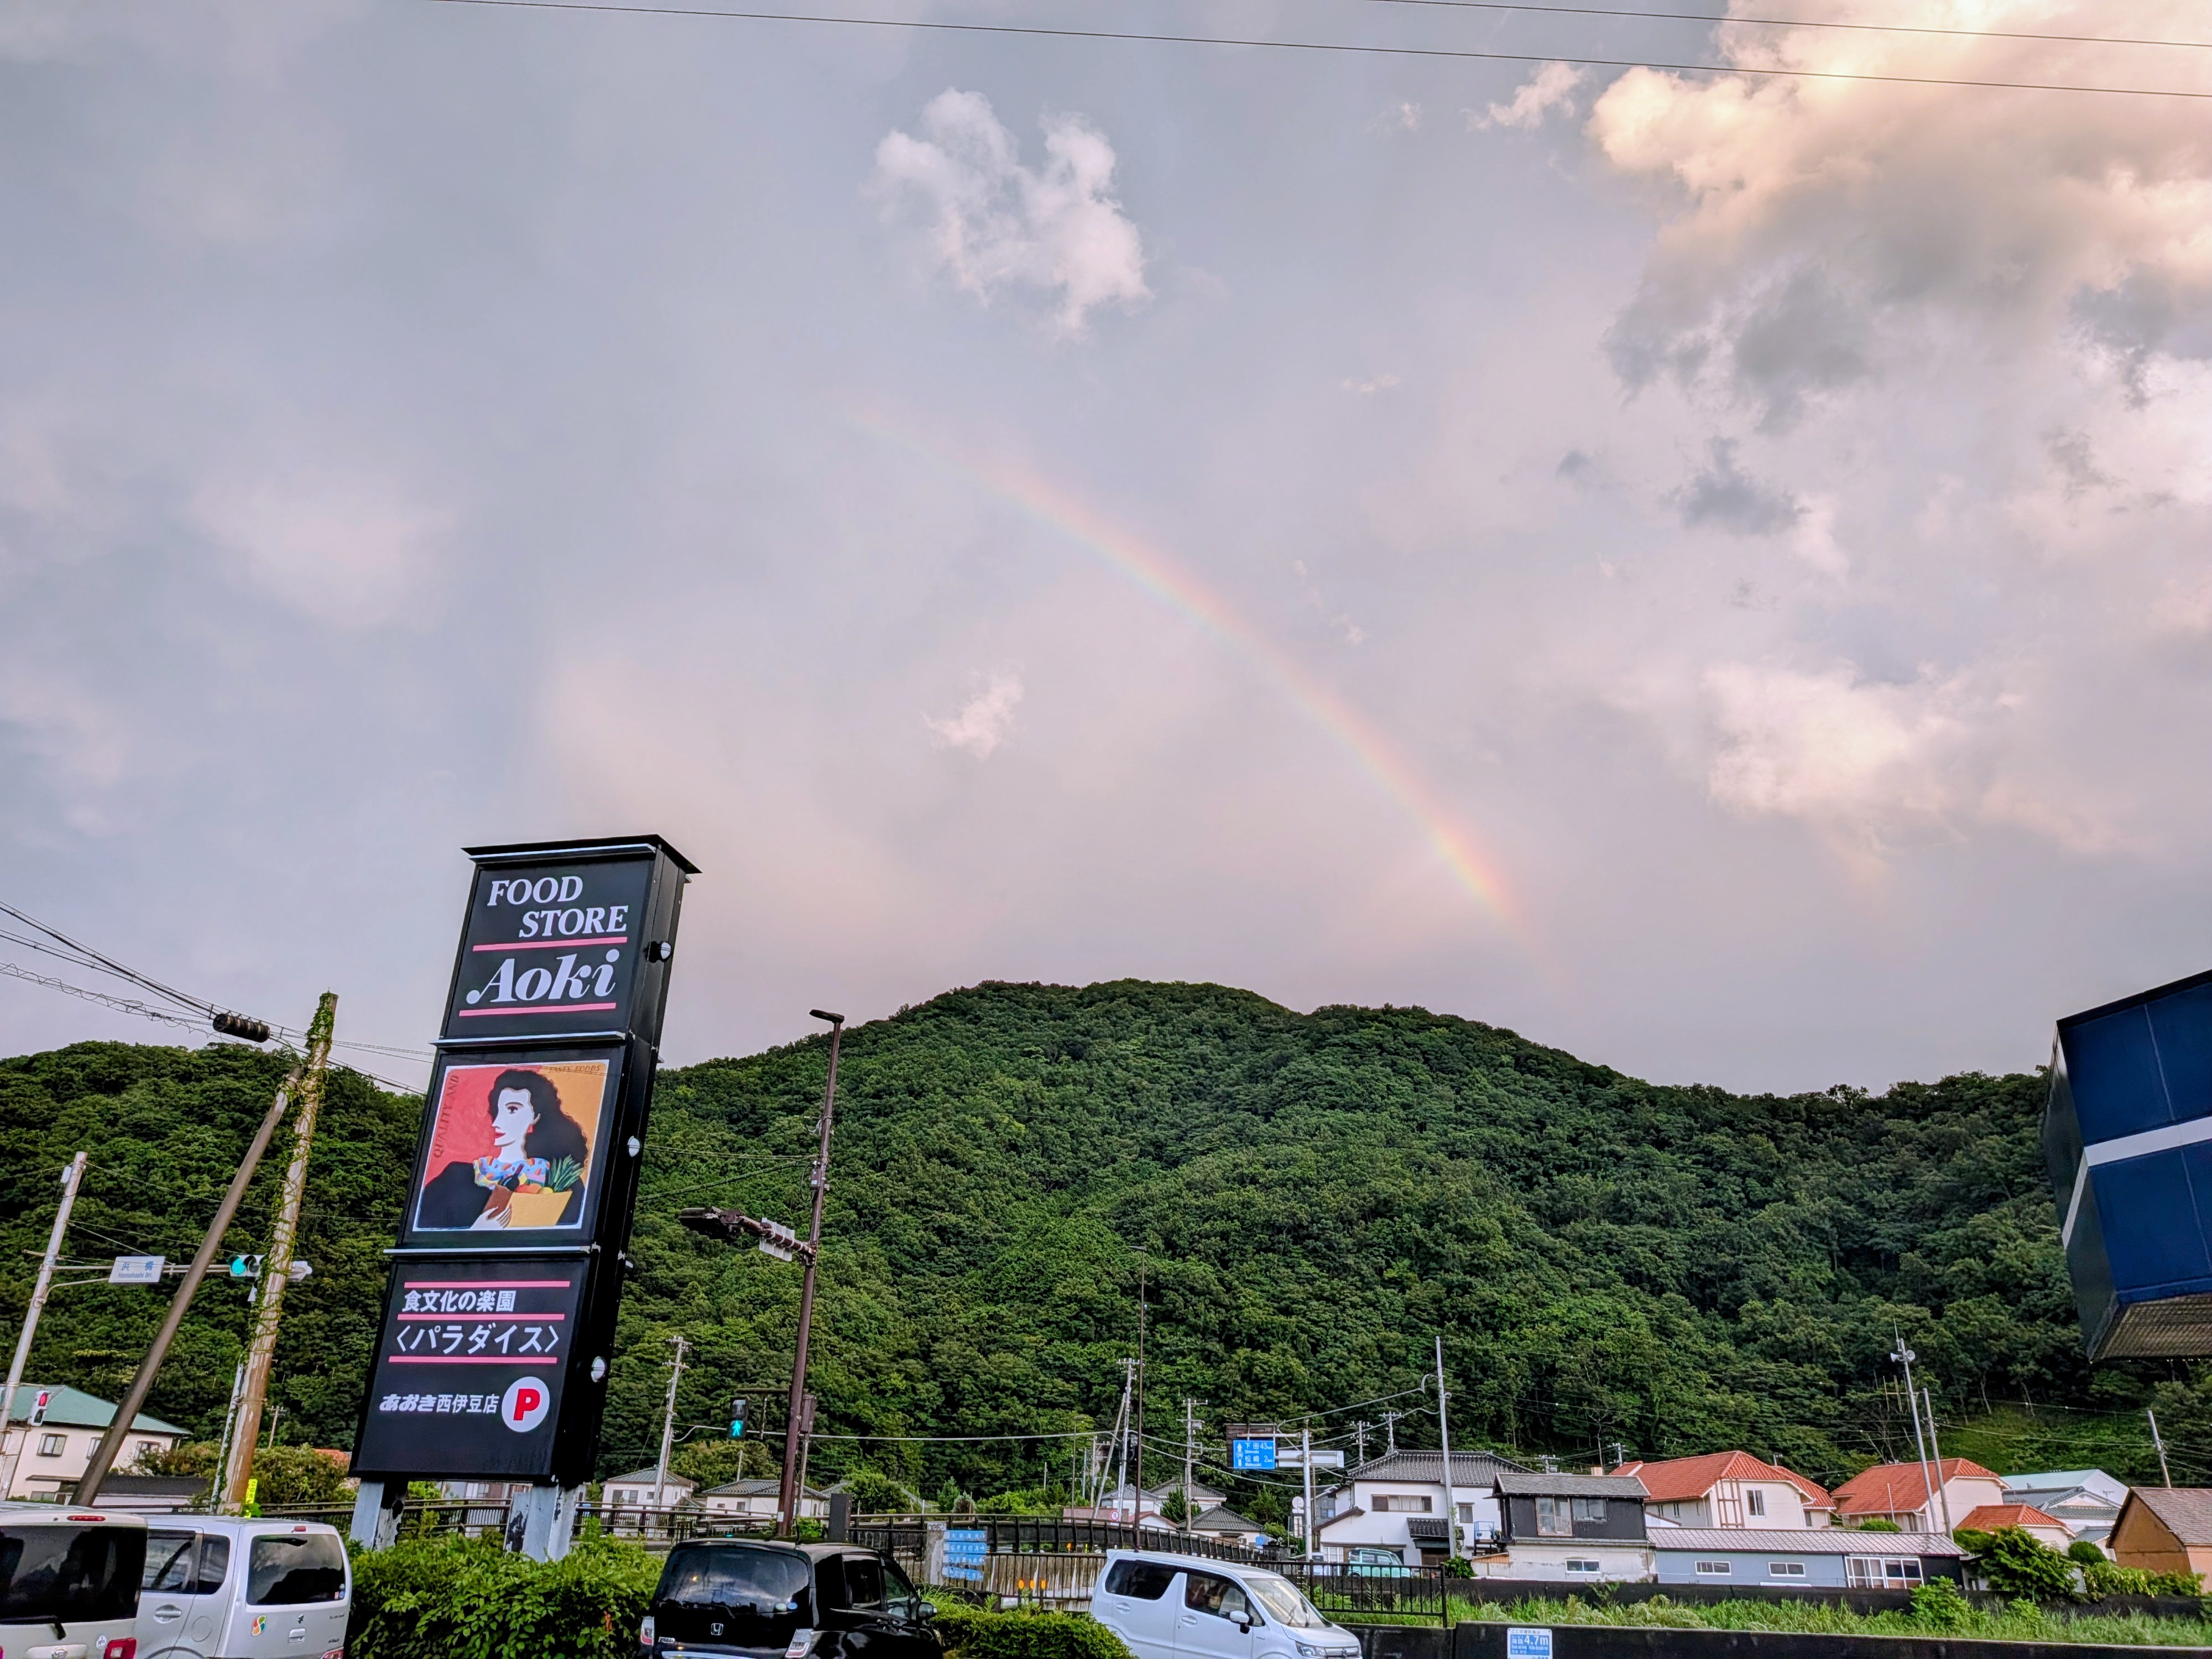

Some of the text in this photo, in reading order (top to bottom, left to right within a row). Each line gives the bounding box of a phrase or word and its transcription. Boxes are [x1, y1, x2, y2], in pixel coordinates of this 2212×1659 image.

[487, 876, 583, 906] FOOD
[519, 905, 629, 938] STORE
[466, 948, 620, 1004] Aoki
[434, 1075, 459, 1158] QUALITY AND
[402, 1290, 517, 1312] 食文化の楽園
[379, 1394, 500, 1413] あおき西伊豆店
[513, 1388, 541, 1421] P
